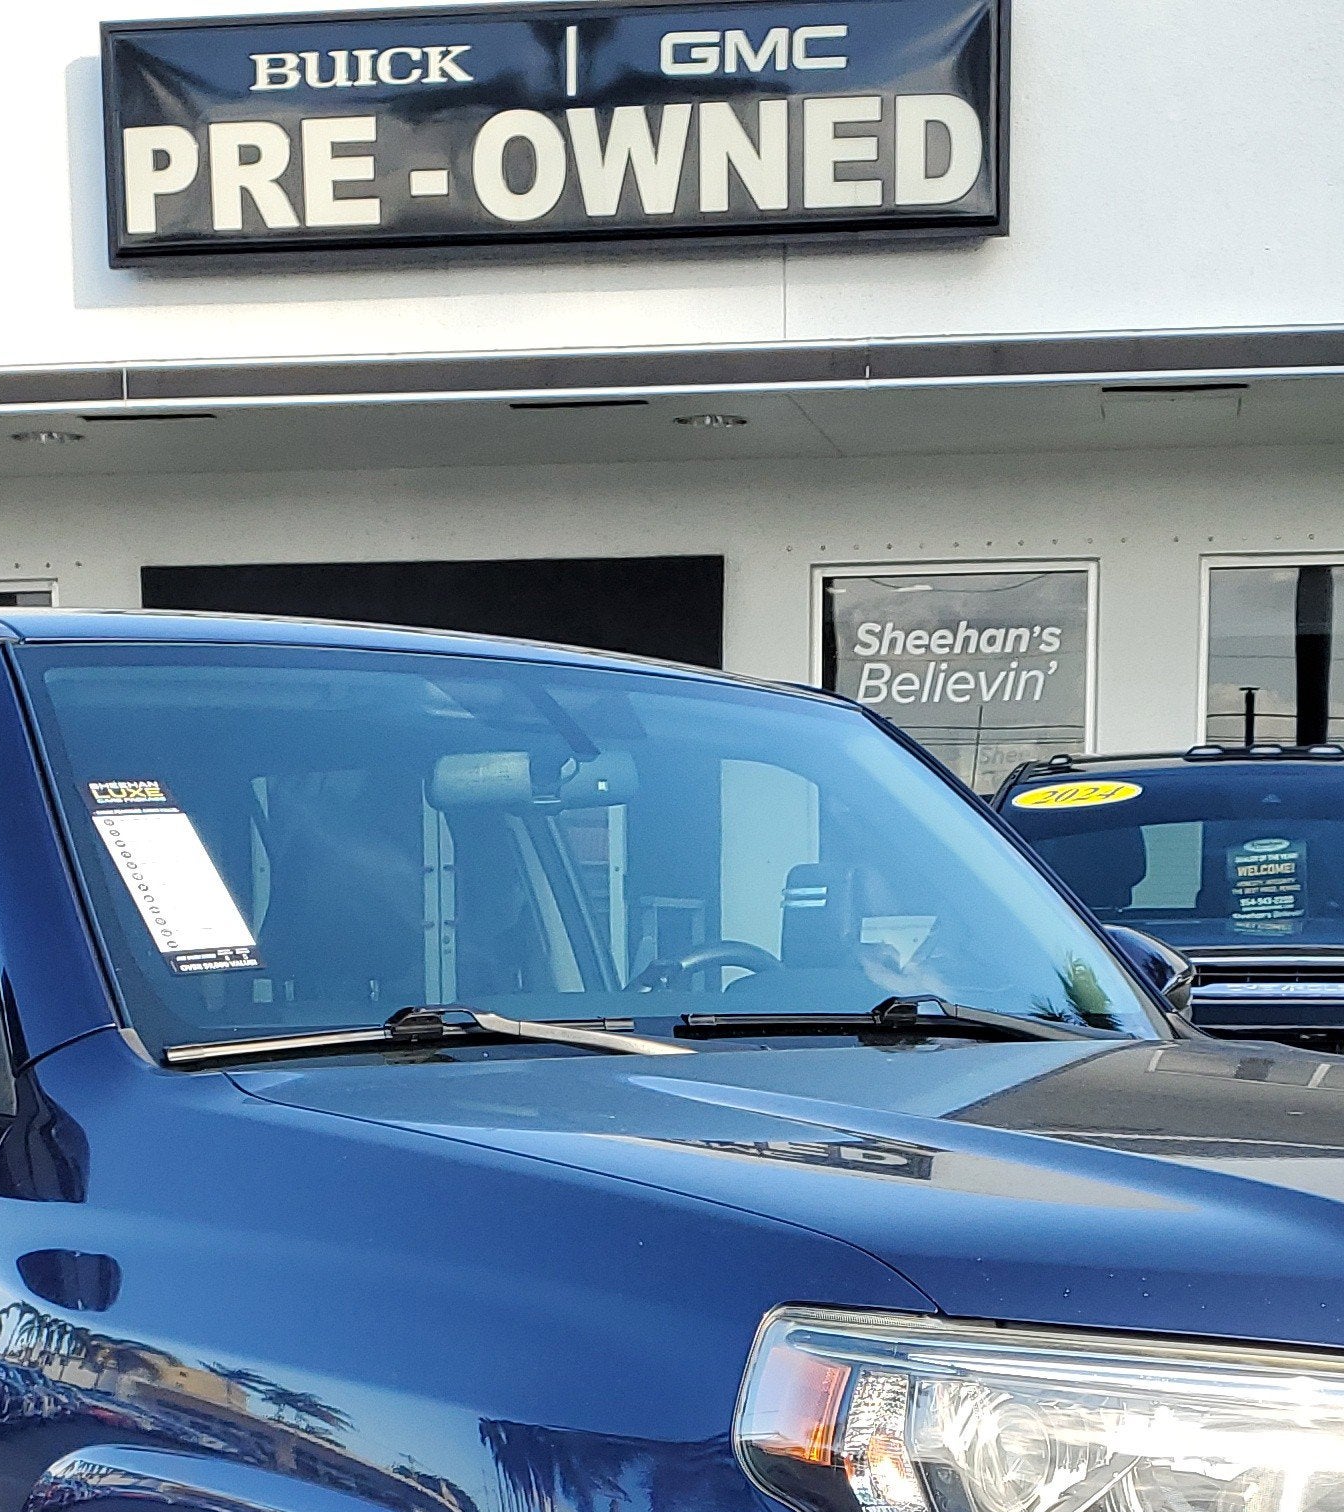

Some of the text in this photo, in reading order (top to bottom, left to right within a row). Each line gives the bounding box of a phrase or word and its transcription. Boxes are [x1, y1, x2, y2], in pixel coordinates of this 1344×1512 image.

[249, 25, 850, 92] BUICK GMC
[853, 620, 1062, 658] Sheehan's
[857, 660, 1057, 704] Believin'
[91, 787, 165, 800] LUXE
[1032, 785, 1125, 805] 2024
[1237, 862, 1296, 877] WELCOME!
